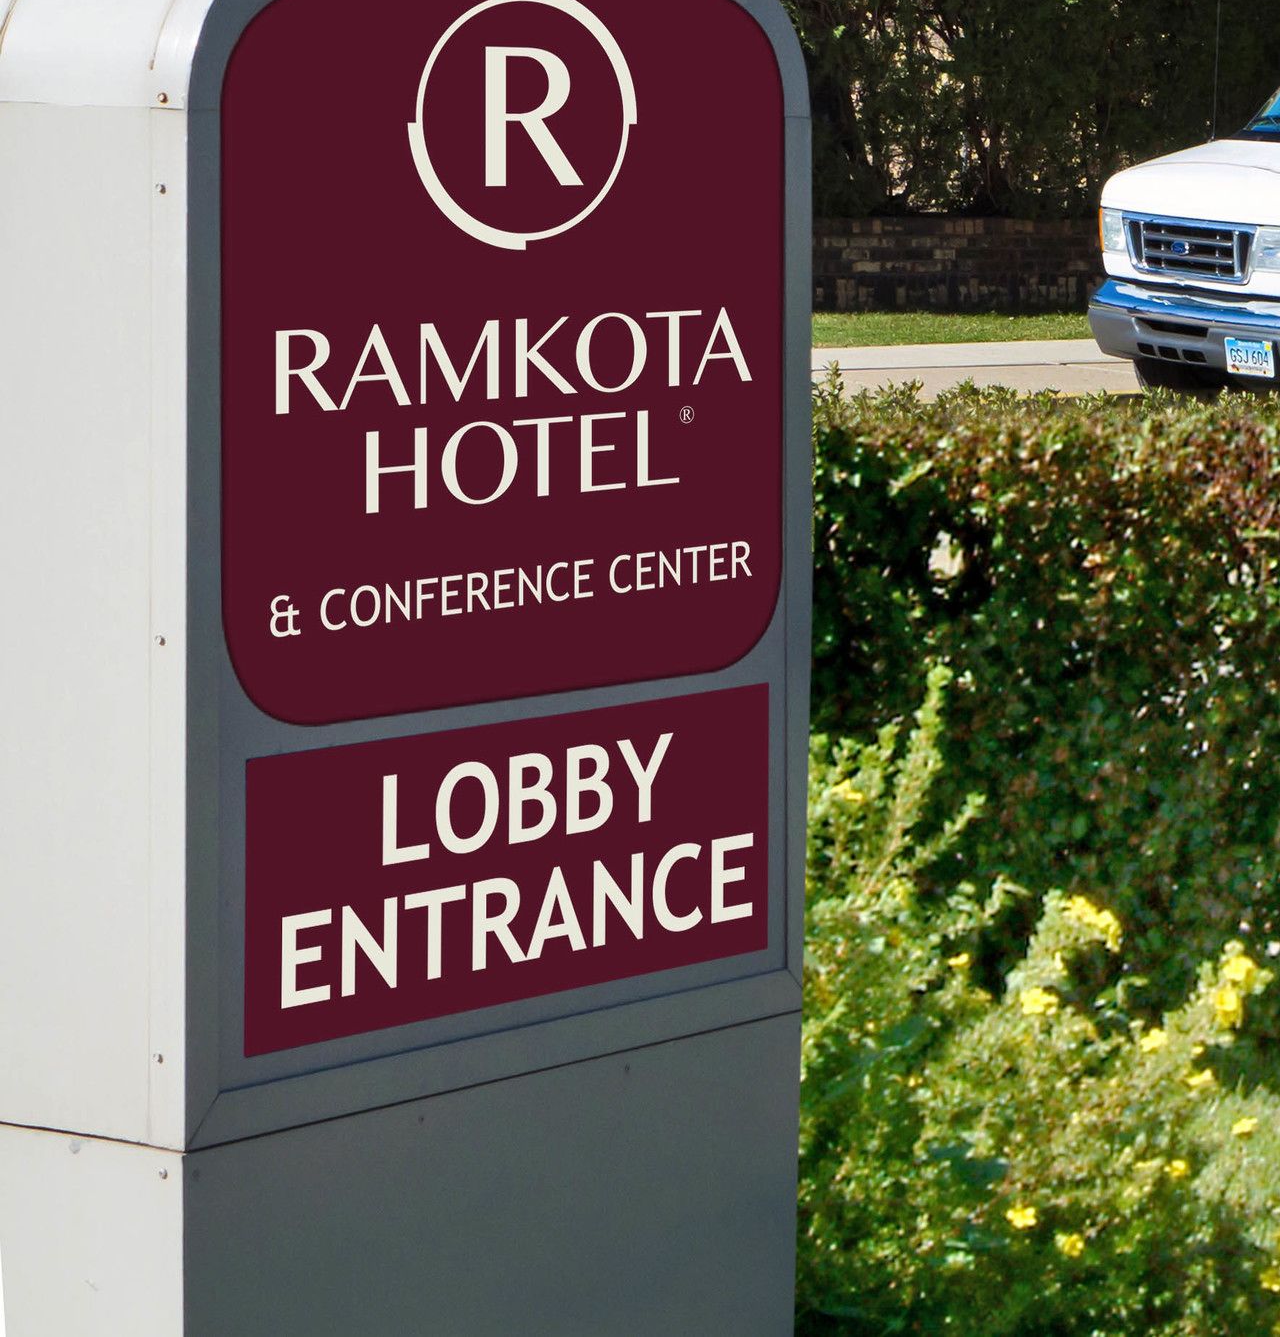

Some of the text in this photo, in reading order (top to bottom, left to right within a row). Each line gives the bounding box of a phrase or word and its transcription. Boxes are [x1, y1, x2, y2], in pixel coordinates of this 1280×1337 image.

[274, 305, 753, 415] RAMKOTA
[269, 540, 753, 639] & CONFERENCE CENTER
[381, 732, 674, 867] LOBBY
[280, 832, 754, 1010] ENTRANCE
